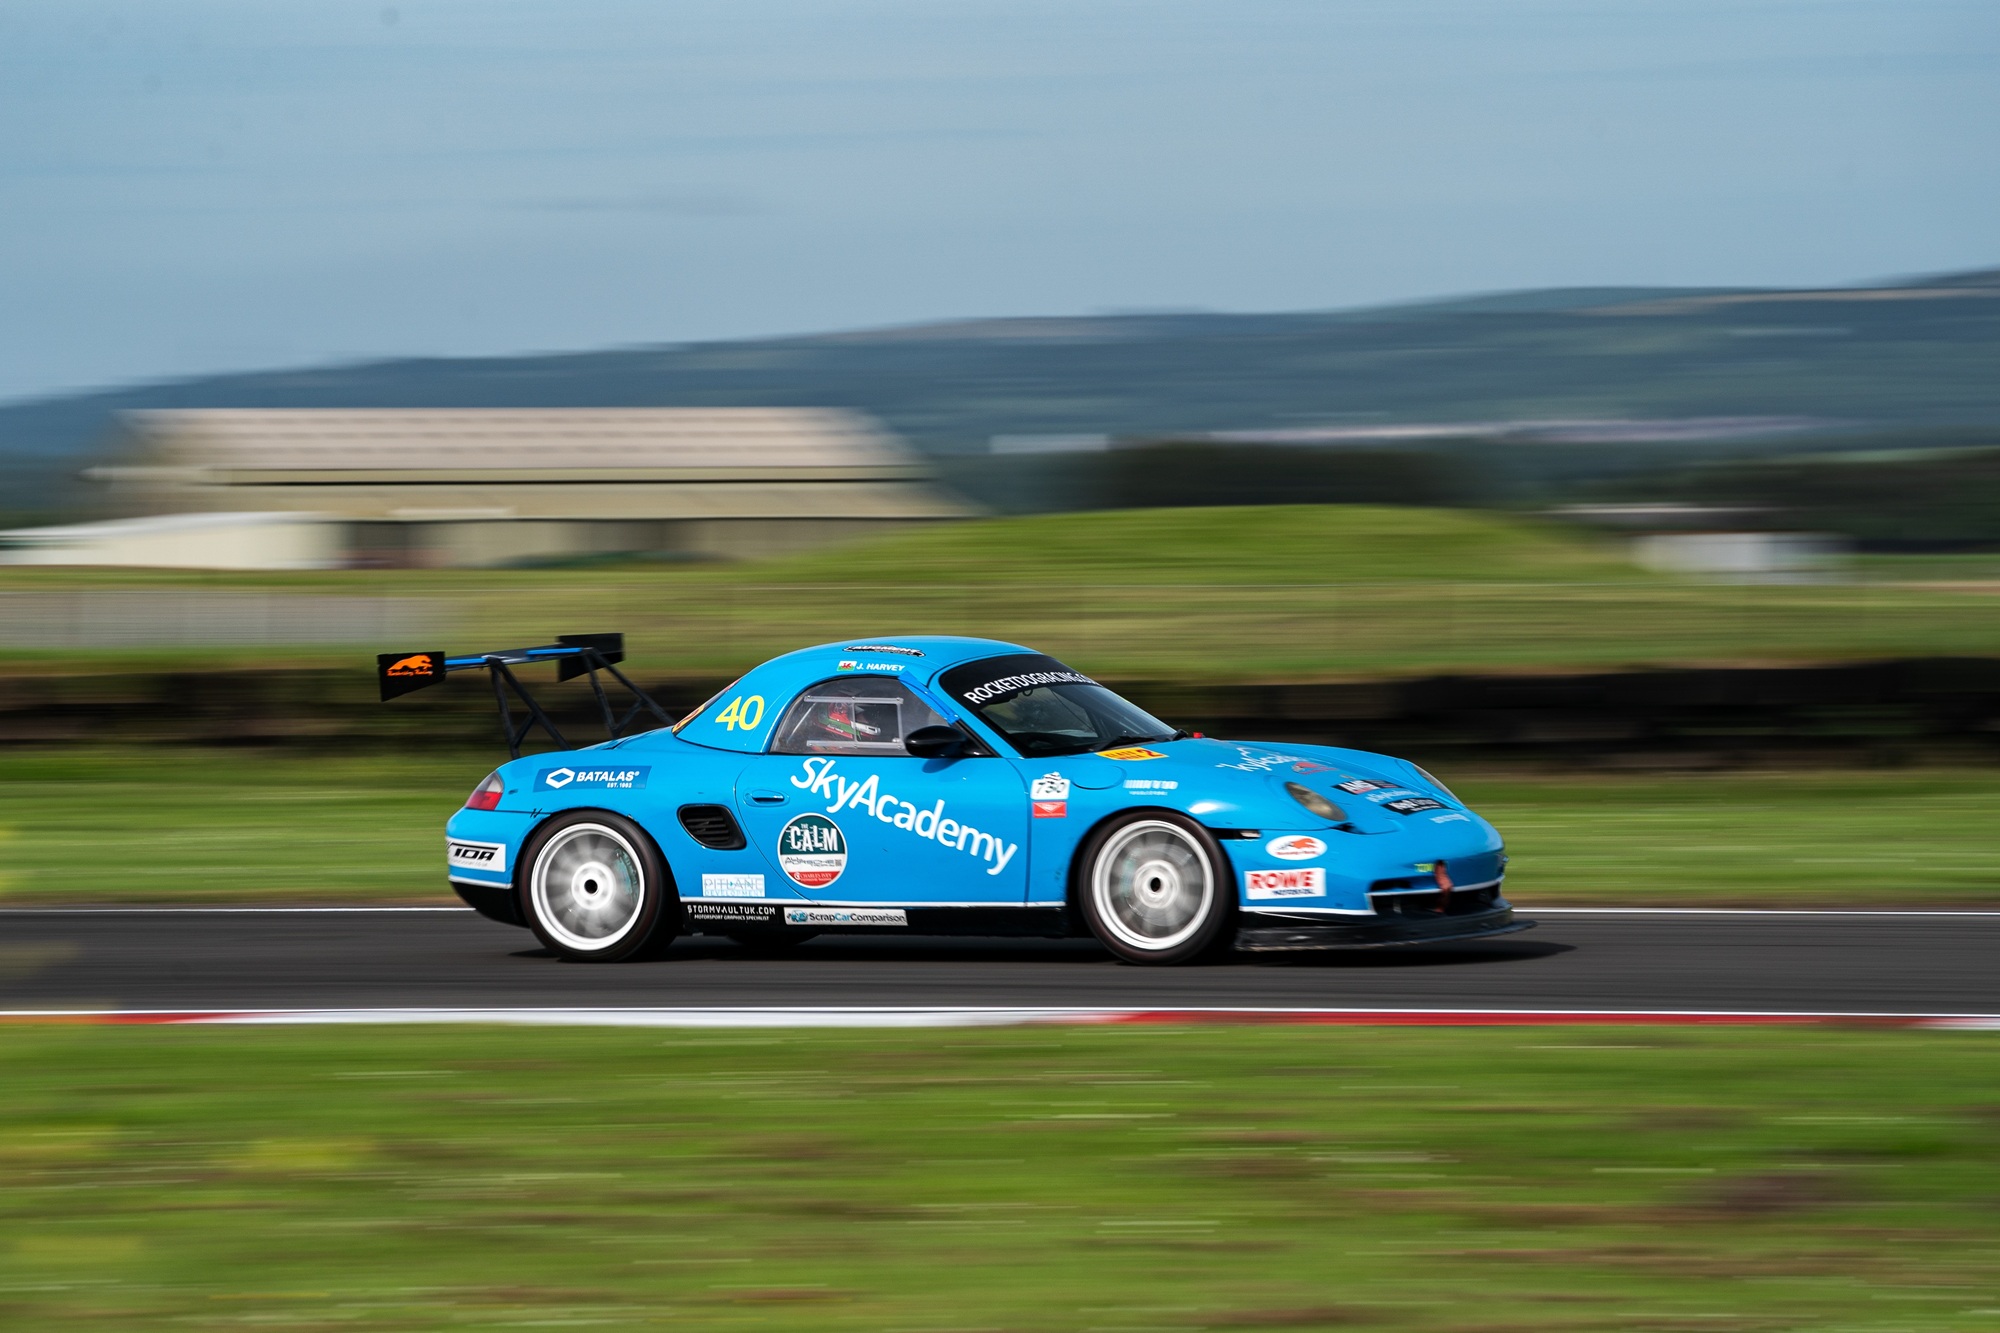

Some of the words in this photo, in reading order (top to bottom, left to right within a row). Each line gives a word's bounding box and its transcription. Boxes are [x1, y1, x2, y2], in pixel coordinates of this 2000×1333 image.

[866, 663, 905, 671] HARVEY
[715, 695, 765, 731] 40
[790, 757, 1018, 876] SkyAcademy
[788, 825, 838, 851] CALM
[704, 879, 763, 889] PITLANE
[1248, 871, 1314, 889] ROWE
[687, 905, 776, 915] STORMVAULTUK.COM
[809, 913, 905, 922] ScrapCarComparison
